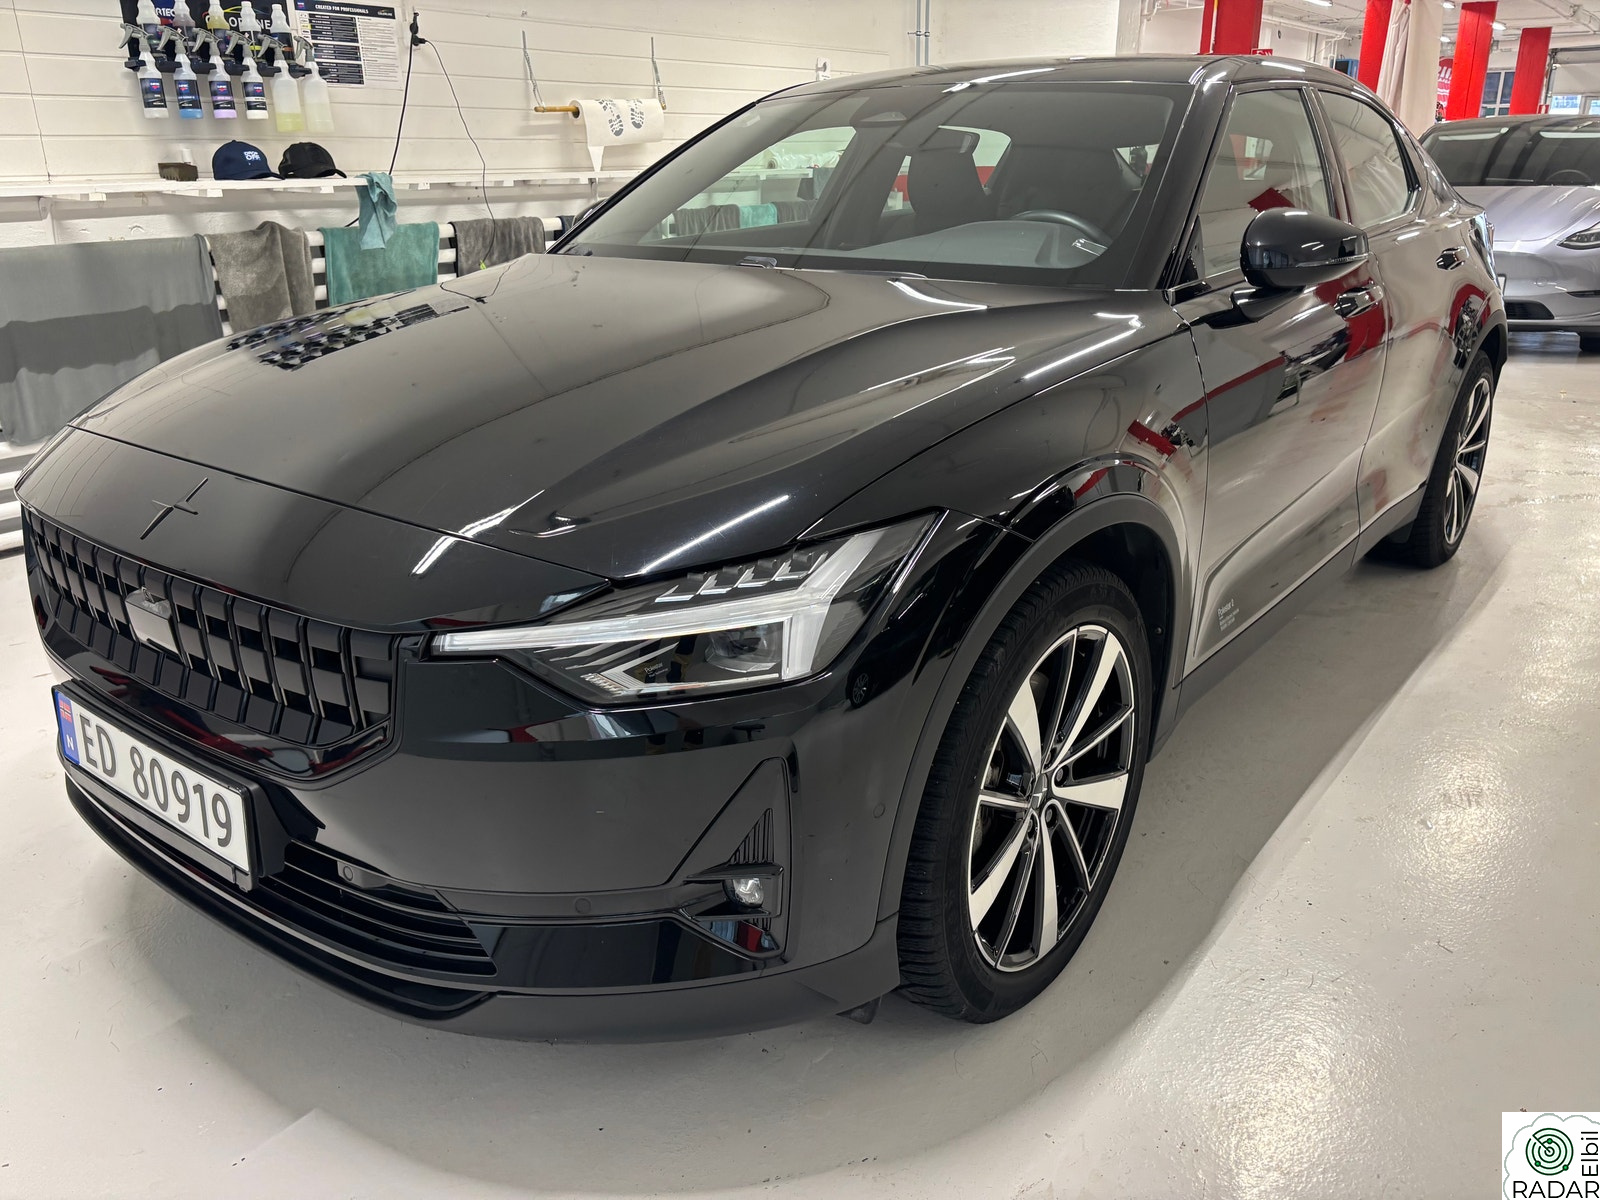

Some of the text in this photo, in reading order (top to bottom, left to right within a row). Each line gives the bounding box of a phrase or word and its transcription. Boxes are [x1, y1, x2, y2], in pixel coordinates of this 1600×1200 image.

[66, 734, 75, 751] N
[79, 713, 232, 848] ED 80919
